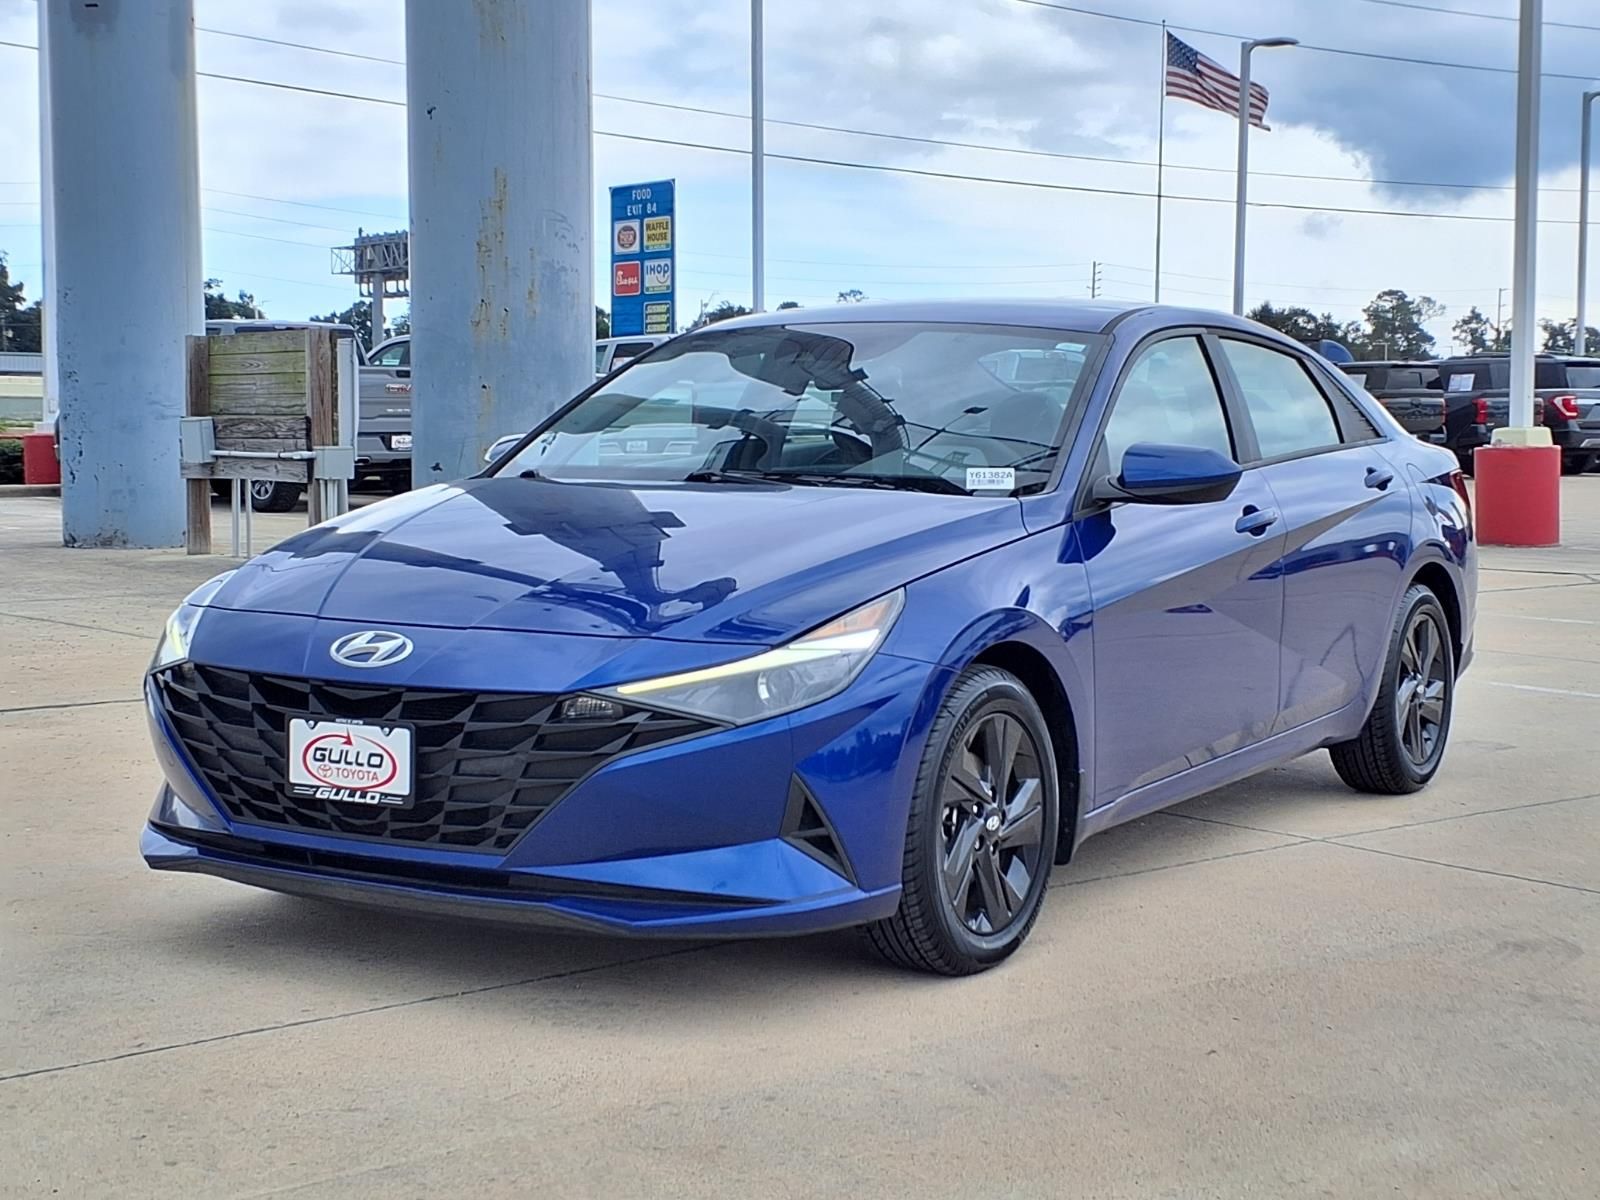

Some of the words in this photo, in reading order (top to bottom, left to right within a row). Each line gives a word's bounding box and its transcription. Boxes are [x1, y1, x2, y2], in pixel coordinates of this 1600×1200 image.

[632, 188, 652, 201] FOOD
[627, 203, 642, 216] EXIT
[646, 202, 657, 214] 84
[646, 221, 669, 232] WAFFLE
[647, 232, 668, 242] HOUSE
[313, 746, 384, 769] GULLO
[335, 767, 380, 783] TOYOTA
[315, 787, 382, 805] GULLO
